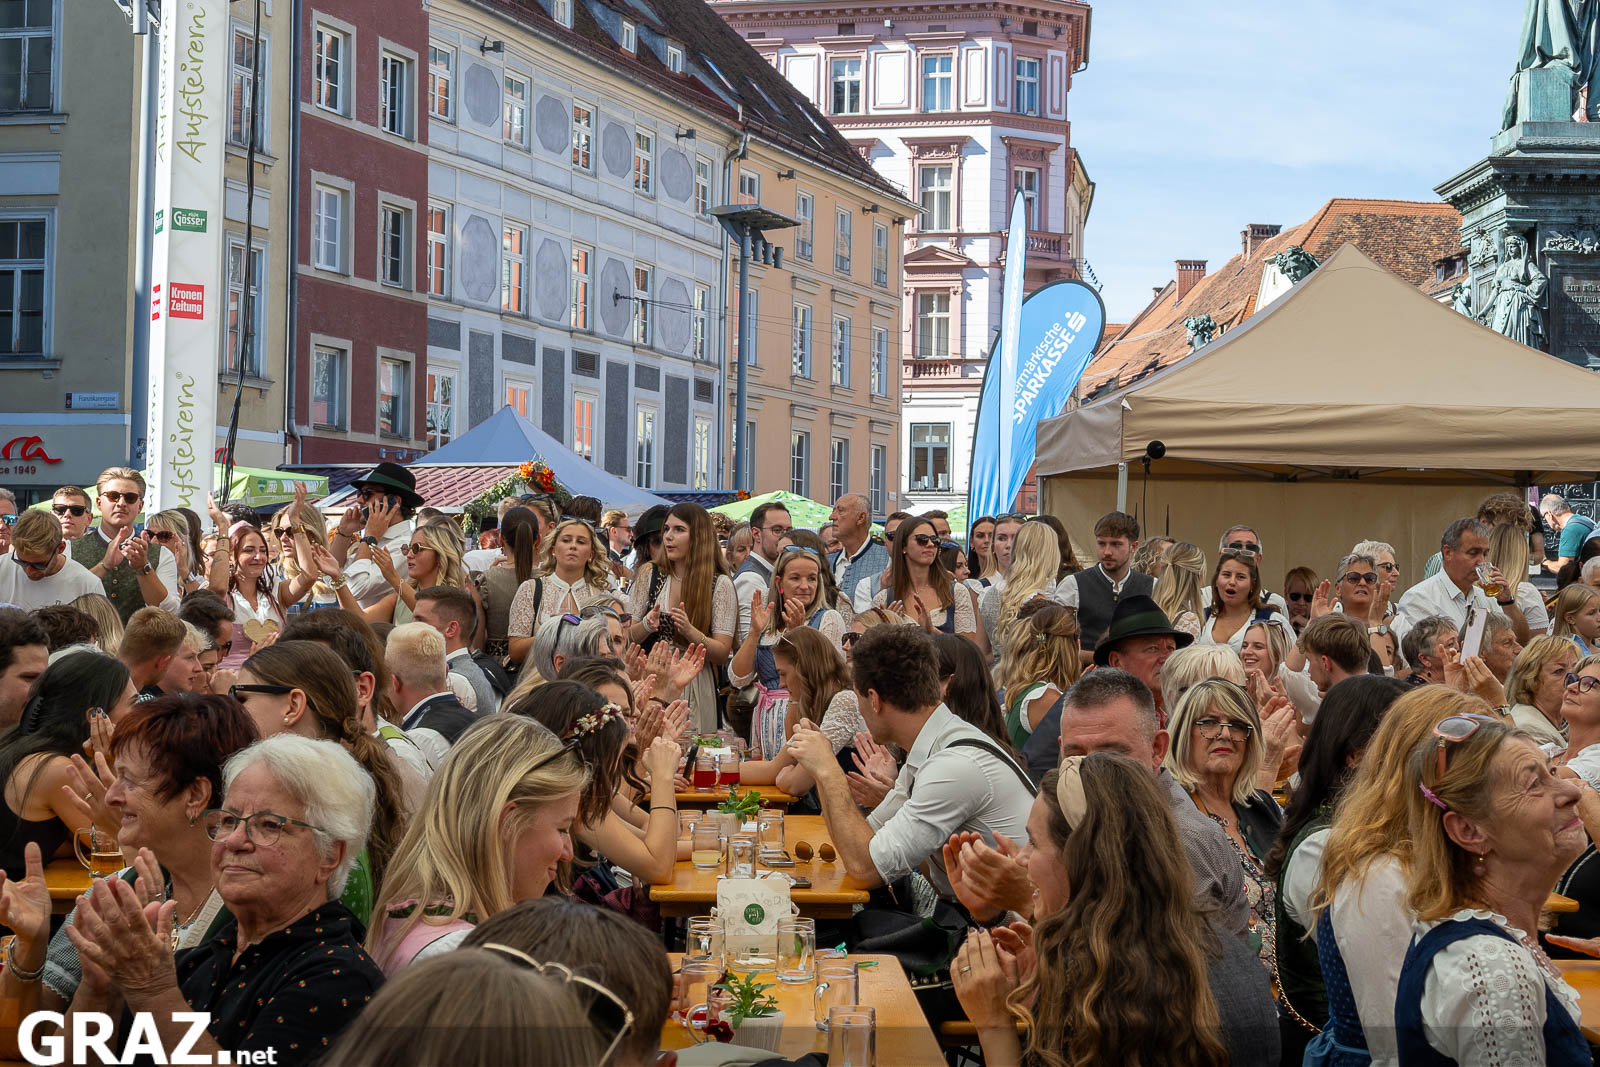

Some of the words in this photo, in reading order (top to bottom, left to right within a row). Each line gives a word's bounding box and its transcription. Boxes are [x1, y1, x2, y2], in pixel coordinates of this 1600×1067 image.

[173, 211, 206, 226] Gösser
[171, 287, 203, 301] Kronen
[171, 299, 203, 315] Zeitung
[1015, 322, 1063, 397] ermärkische
[14, 465, 37, 474] 1949
